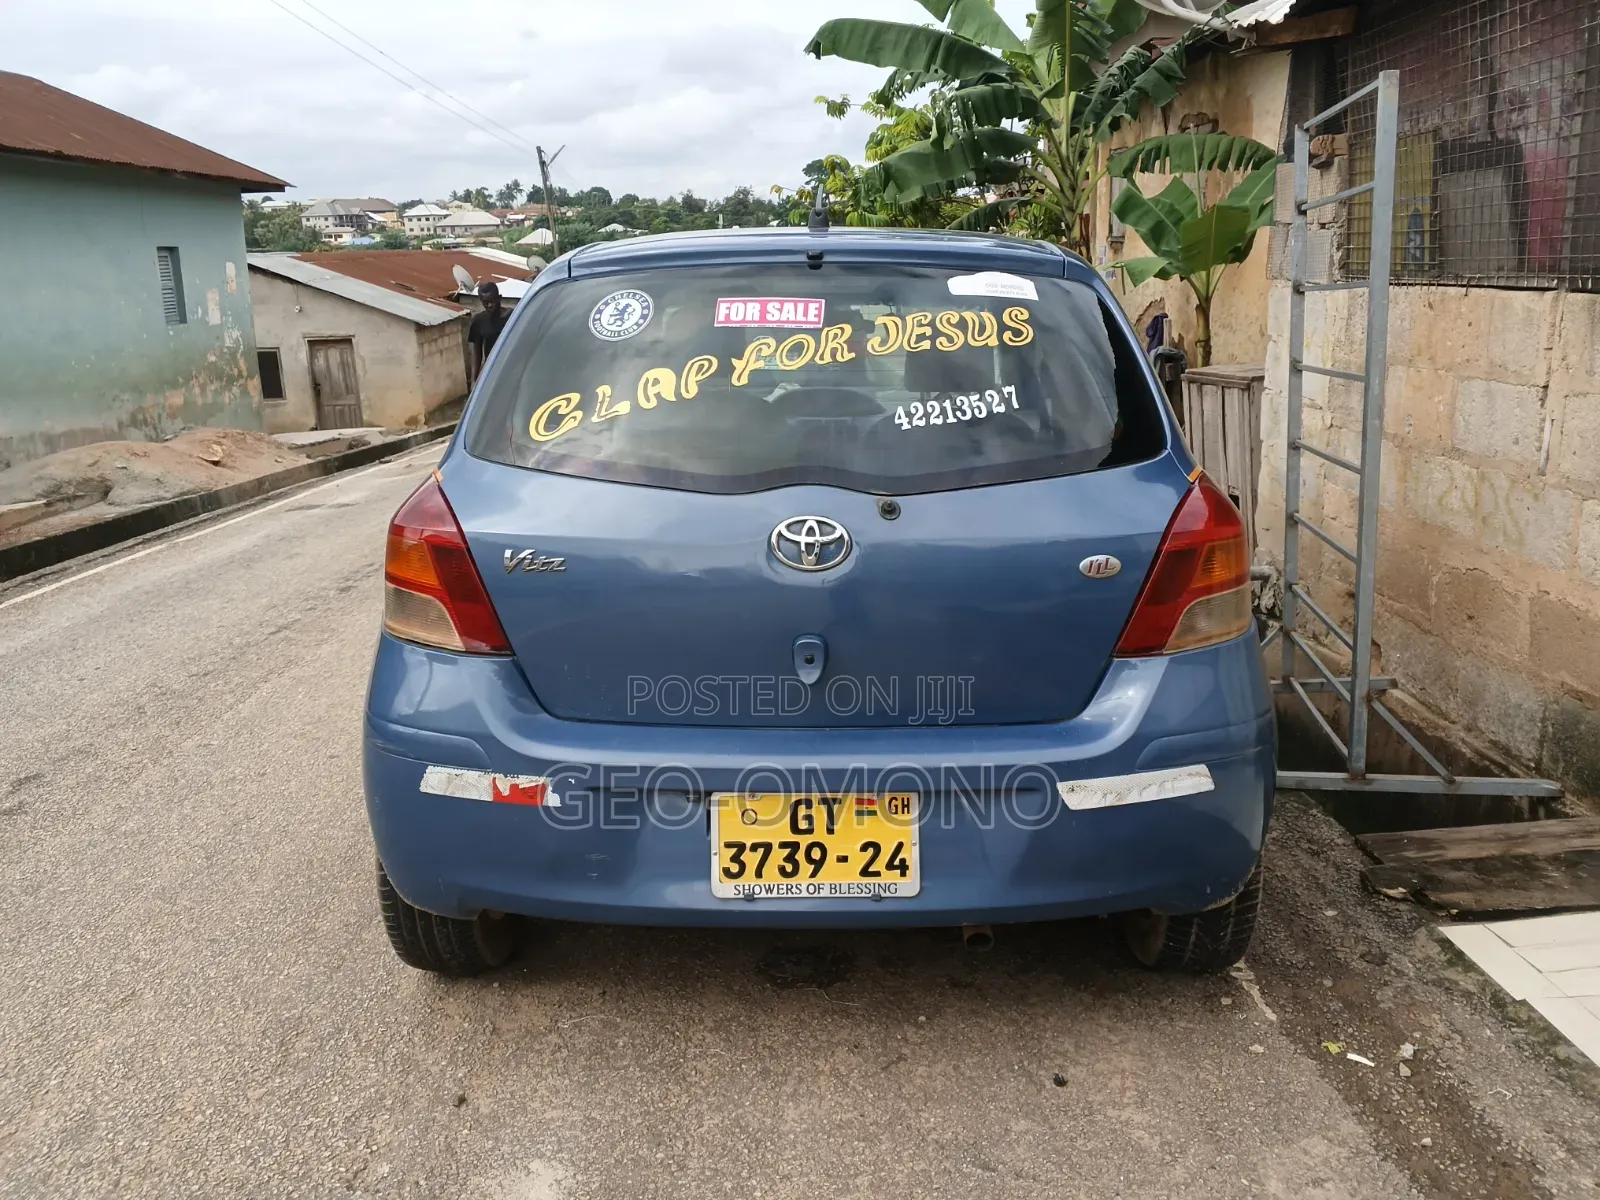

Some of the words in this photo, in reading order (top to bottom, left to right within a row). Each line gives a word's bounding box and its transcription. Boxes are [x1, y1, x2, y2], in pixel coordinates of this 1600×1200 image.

[607, 292, 649, 308] CHELSEA
[717, 301, 761, 322] FOR
[765, 301, 820, 322] SALE
[528, 354, 718, 441] CLAP
[731, 323, 856, 387] FOR
[866, 306, 1034, 356] JESUS
[894, 384, 1020, 431] 42213527
[503, 549, 567, 574] Vitz
[789, 798, 842, 836] GT
[887, 796, 911, 815] GH
[733, 884, 802, 896] SHOWERS
[806, 883, 825, 896] OF
[829, 883, 898, 896] BLESSING
